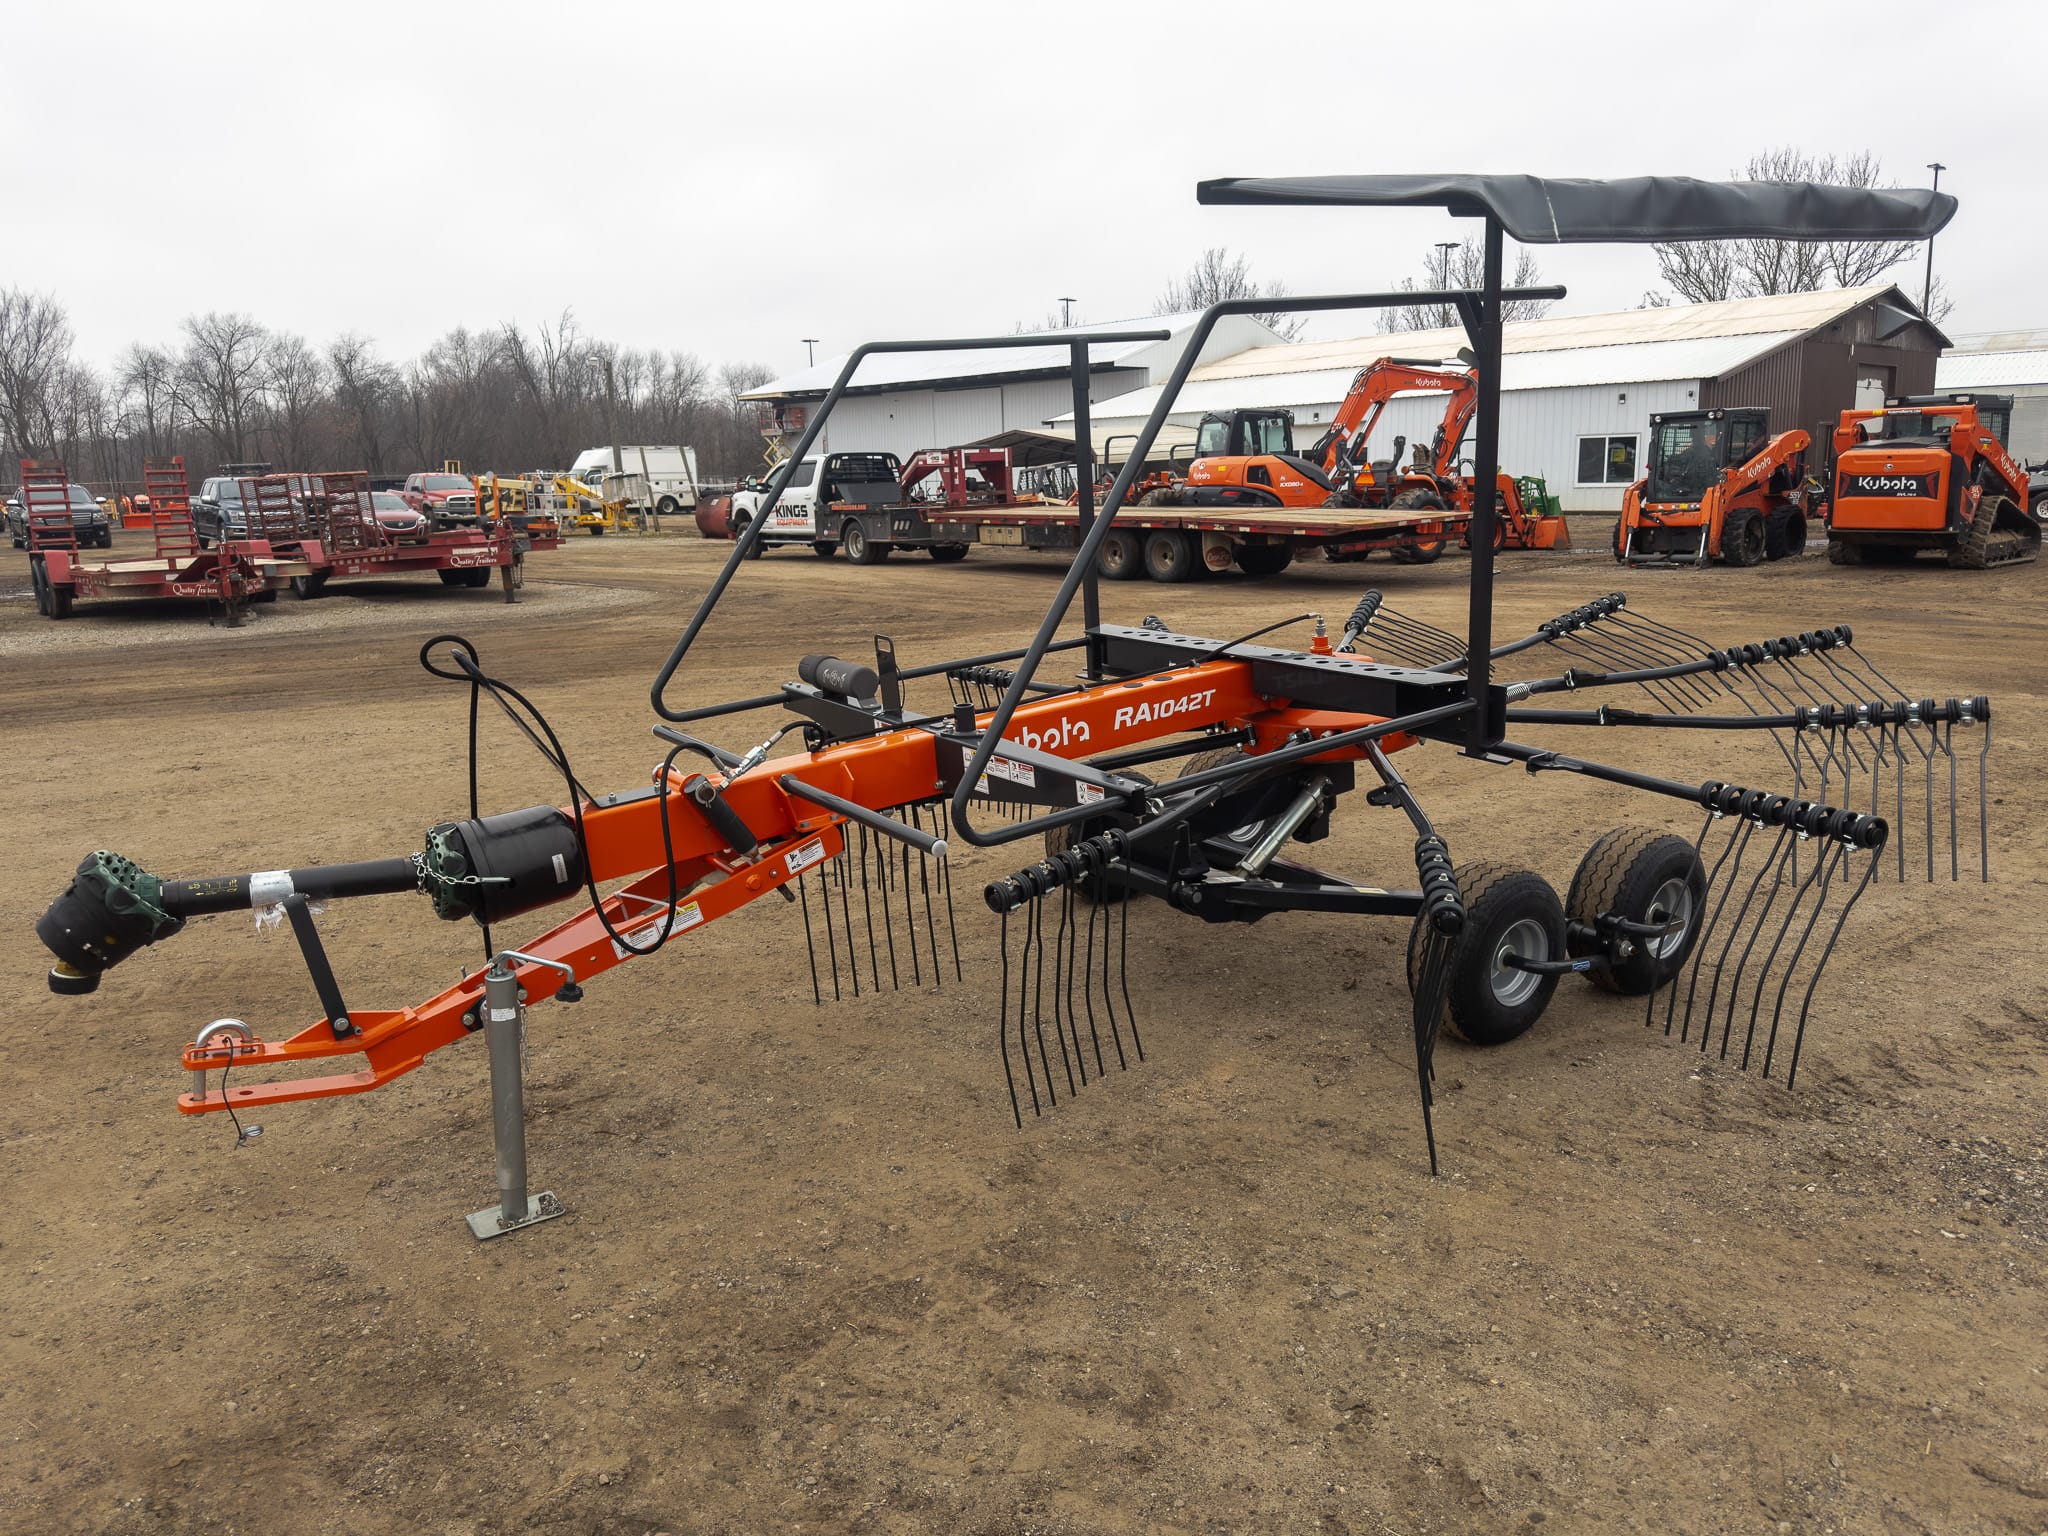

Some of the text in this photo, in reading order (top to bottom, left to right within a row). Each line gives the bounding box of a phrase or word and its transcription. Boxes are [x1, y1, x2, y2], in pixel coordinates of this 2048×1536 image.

[1415, 376, 1441, 386] Kubota
[1747, 456, 1772, 478] Kubota
[2000, 453, 2017, 482] Kubota
[1858, 476, 1917, 490] Kubota
[775, 504, 808, 518] KINGS
[776, 518, 808, 526] EQUIPMENT
[450, 555, 497, 567] Quality Trailers
[172, 583, 195, 596] Quality
[1113, 688, 1217, 731] RA1042T
